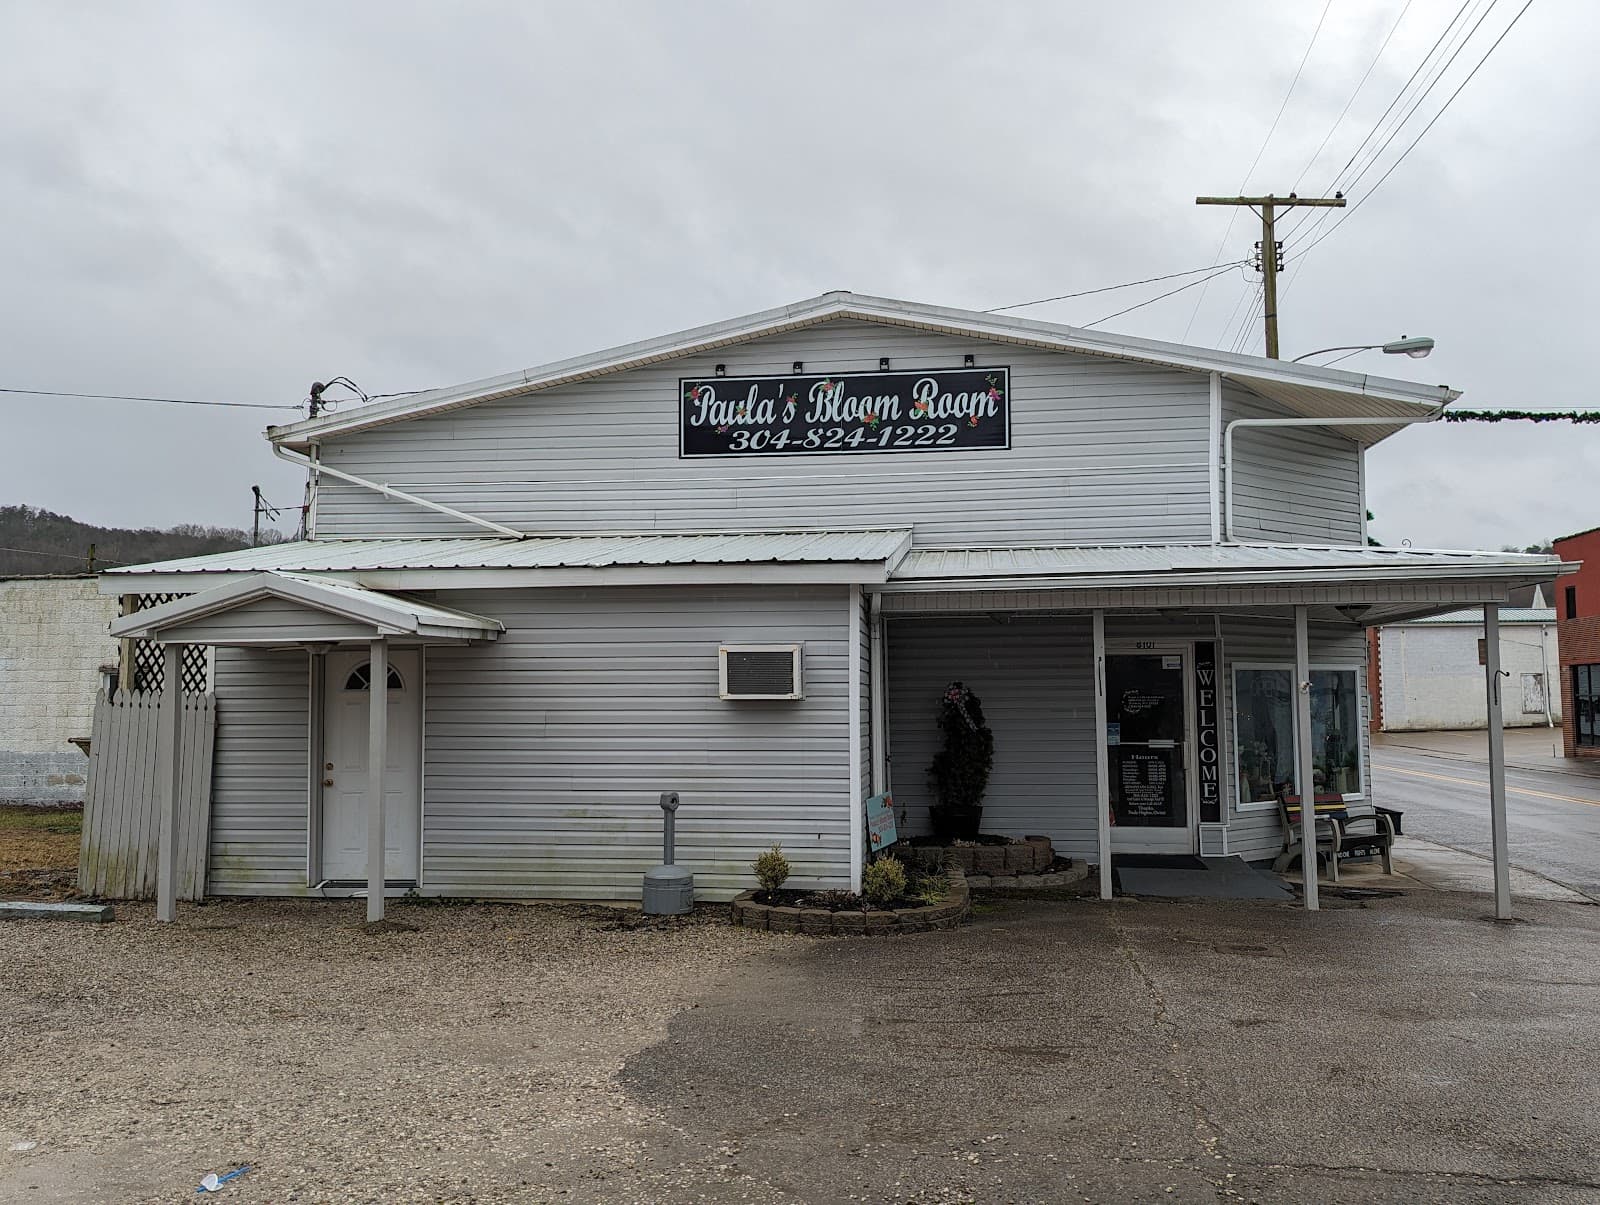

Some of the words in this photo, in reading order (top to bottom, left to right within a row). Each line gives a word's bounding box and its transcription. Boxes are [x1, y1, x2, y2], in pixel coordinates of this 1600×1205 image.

[690, 383, 797, 427] Paula's
[804, 379, 902, 424] Bloom
[909, 377, 998, 421] Room
[728, 423, 959, 451] 304-824-1222
[1196, 669, 1217, 798] WELCOME
